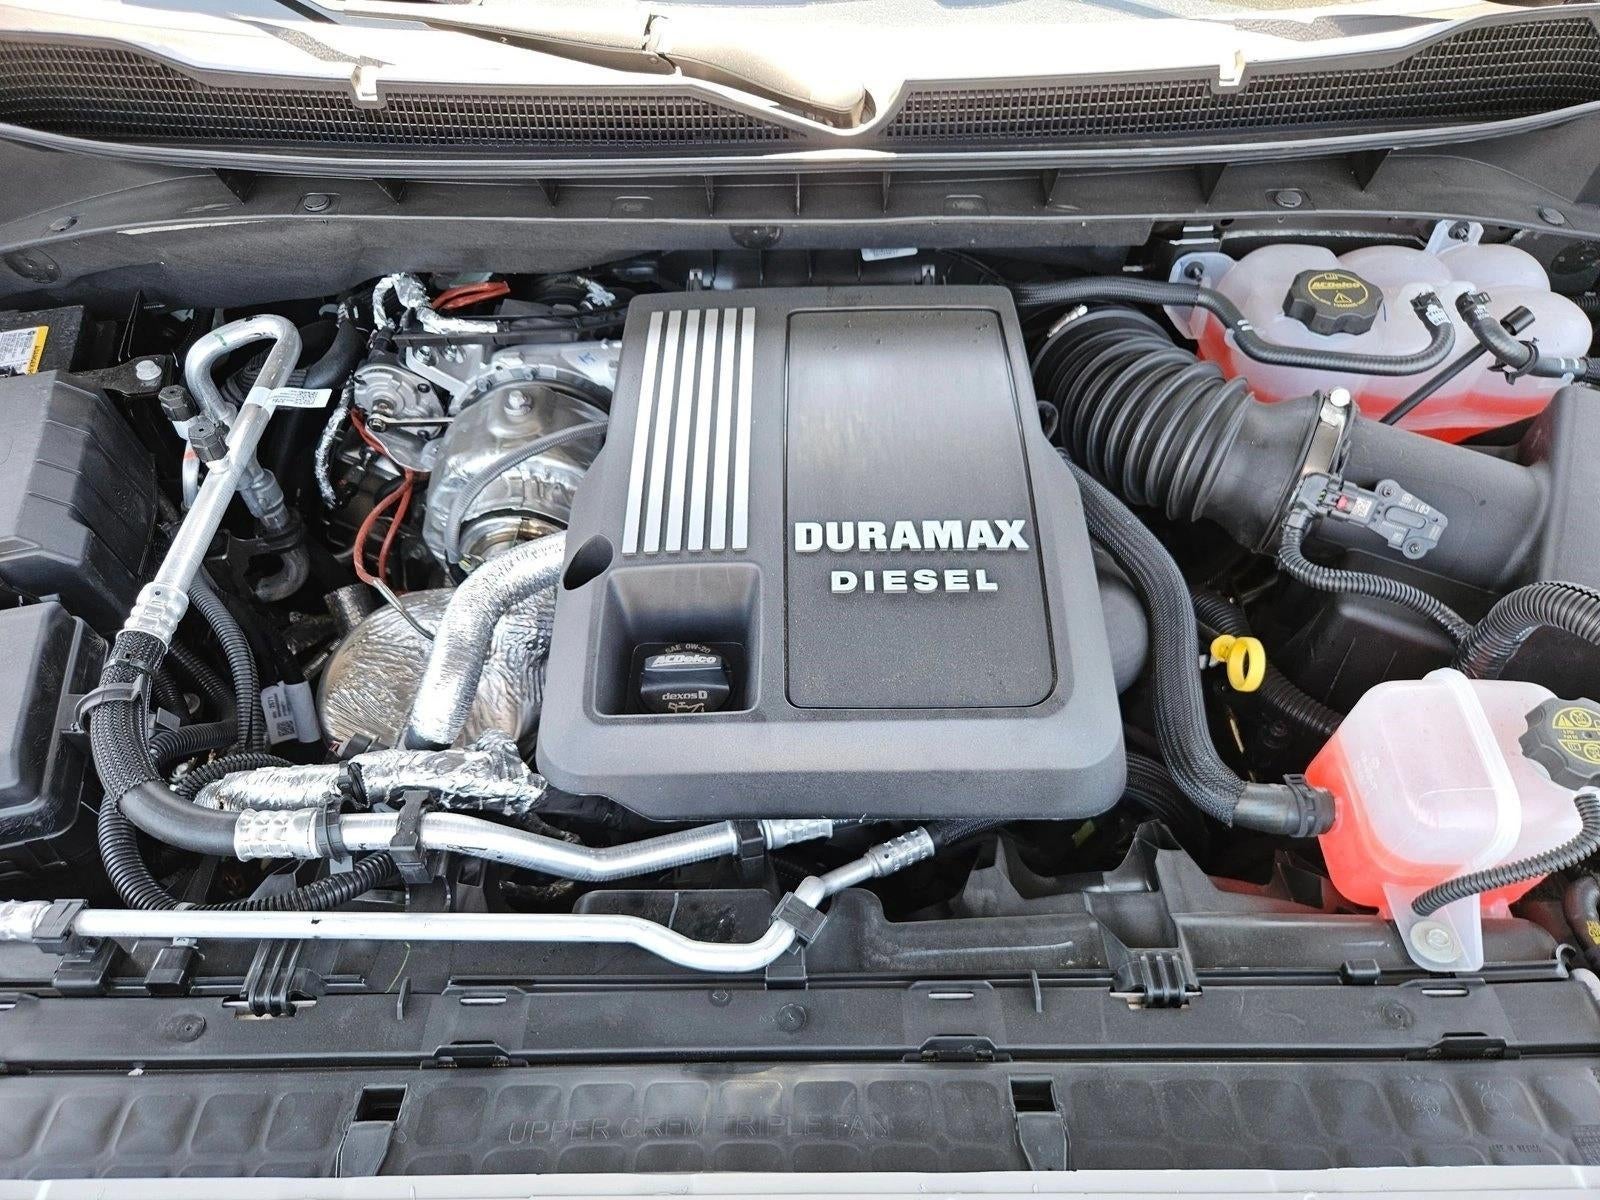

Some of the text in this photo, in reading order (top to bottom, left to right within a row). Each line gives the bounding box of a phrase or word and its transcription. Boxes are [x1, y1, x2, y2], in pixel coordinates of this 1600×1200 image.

[794, 519, 1030, 552] DURAMAX
[831, 569, 999, 593] DIESEL
[651, 654, 717, 667] ACDelco
[665, 643, 711, 655] SAE 0W-20
[507, 1118, 610, 1145] UPPER
[717, 1113, 823, 1138] TRIPLE
[834, 1114, 891, 1139] FAN
